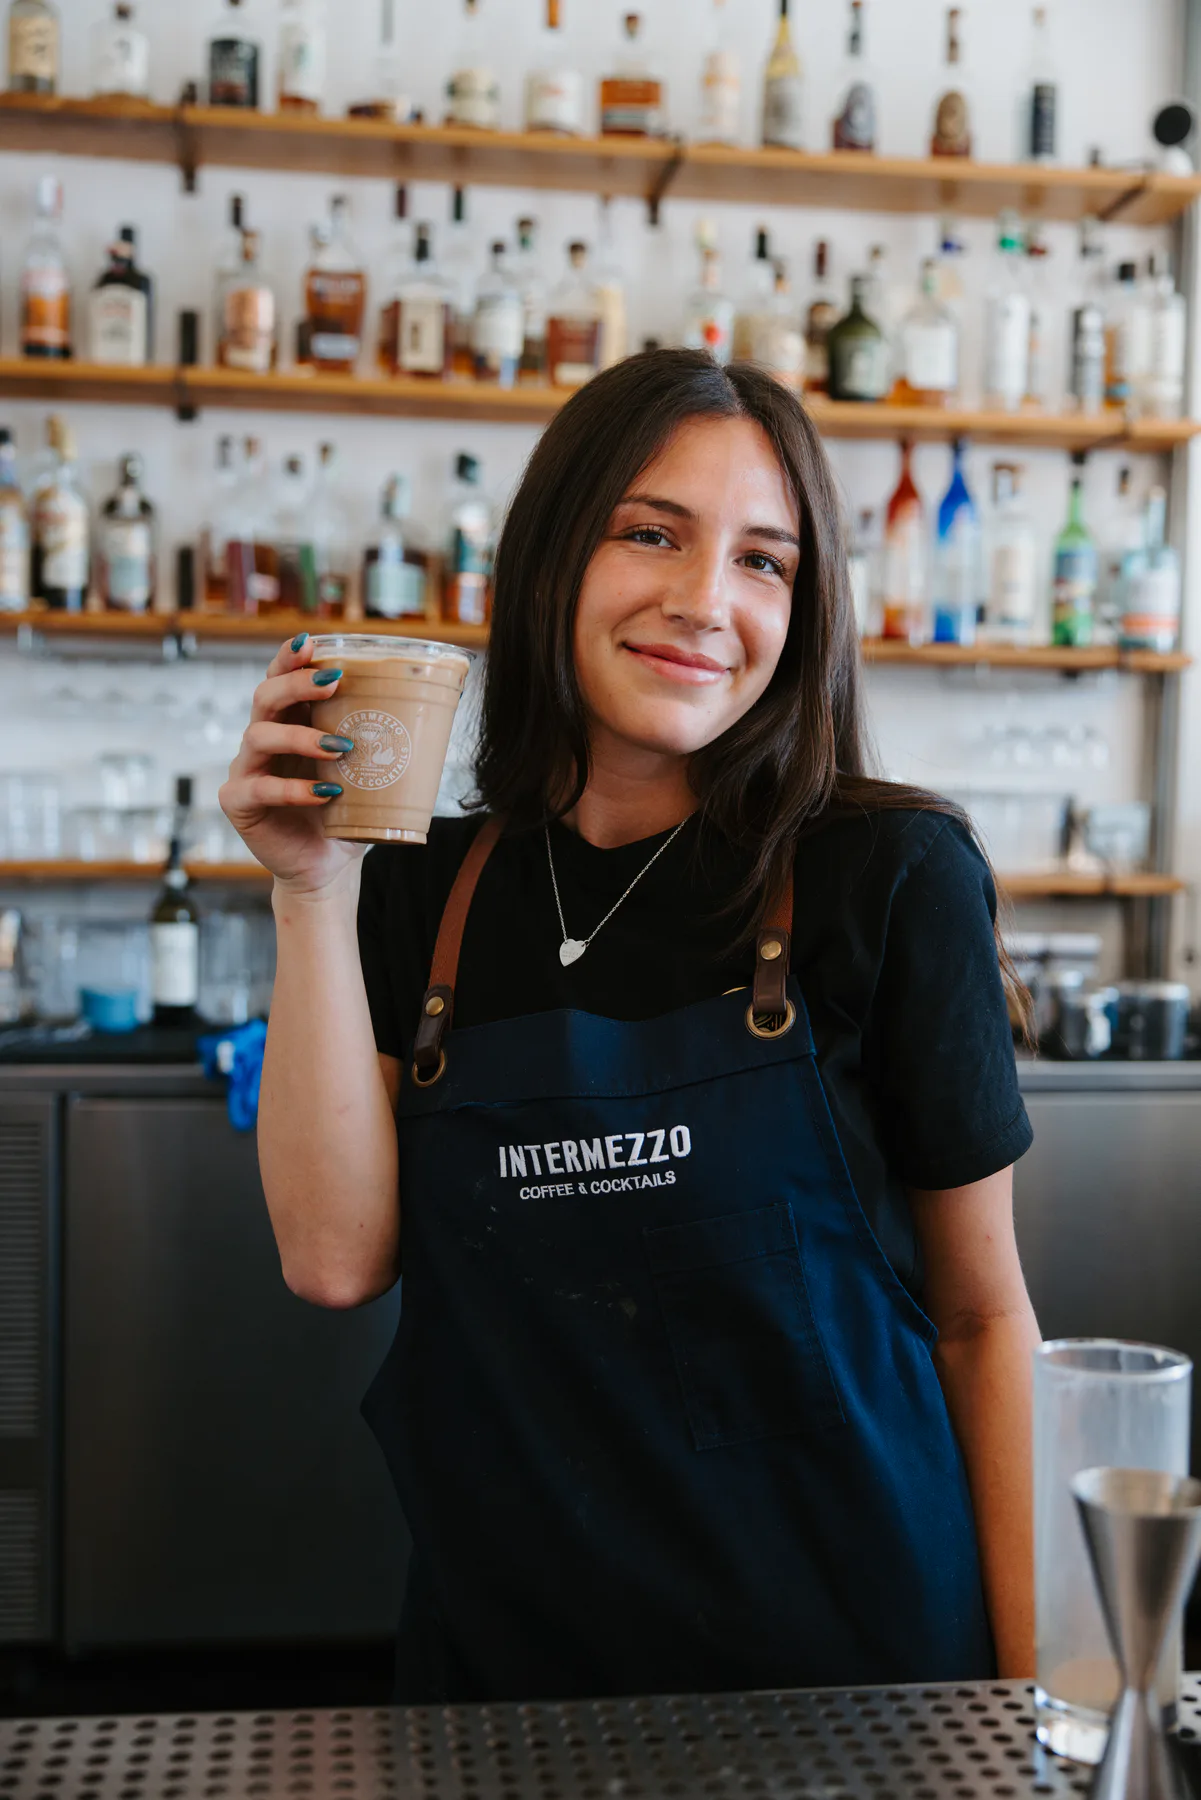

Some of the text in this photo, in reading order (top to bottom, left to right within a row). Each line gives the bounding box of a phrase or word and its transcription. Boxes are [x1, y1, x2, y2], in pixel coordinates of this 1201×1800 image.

[340, 712, 403, 735] INTERMEZZO
[338, 760, 356, 781] FFEE
[368, 747, 408, 787] COCKTAILS
[499, 1125, 692, 1178] INTERMEZZO
[519, 1170, 677, 1200] COFFEE & COCKTAILS
